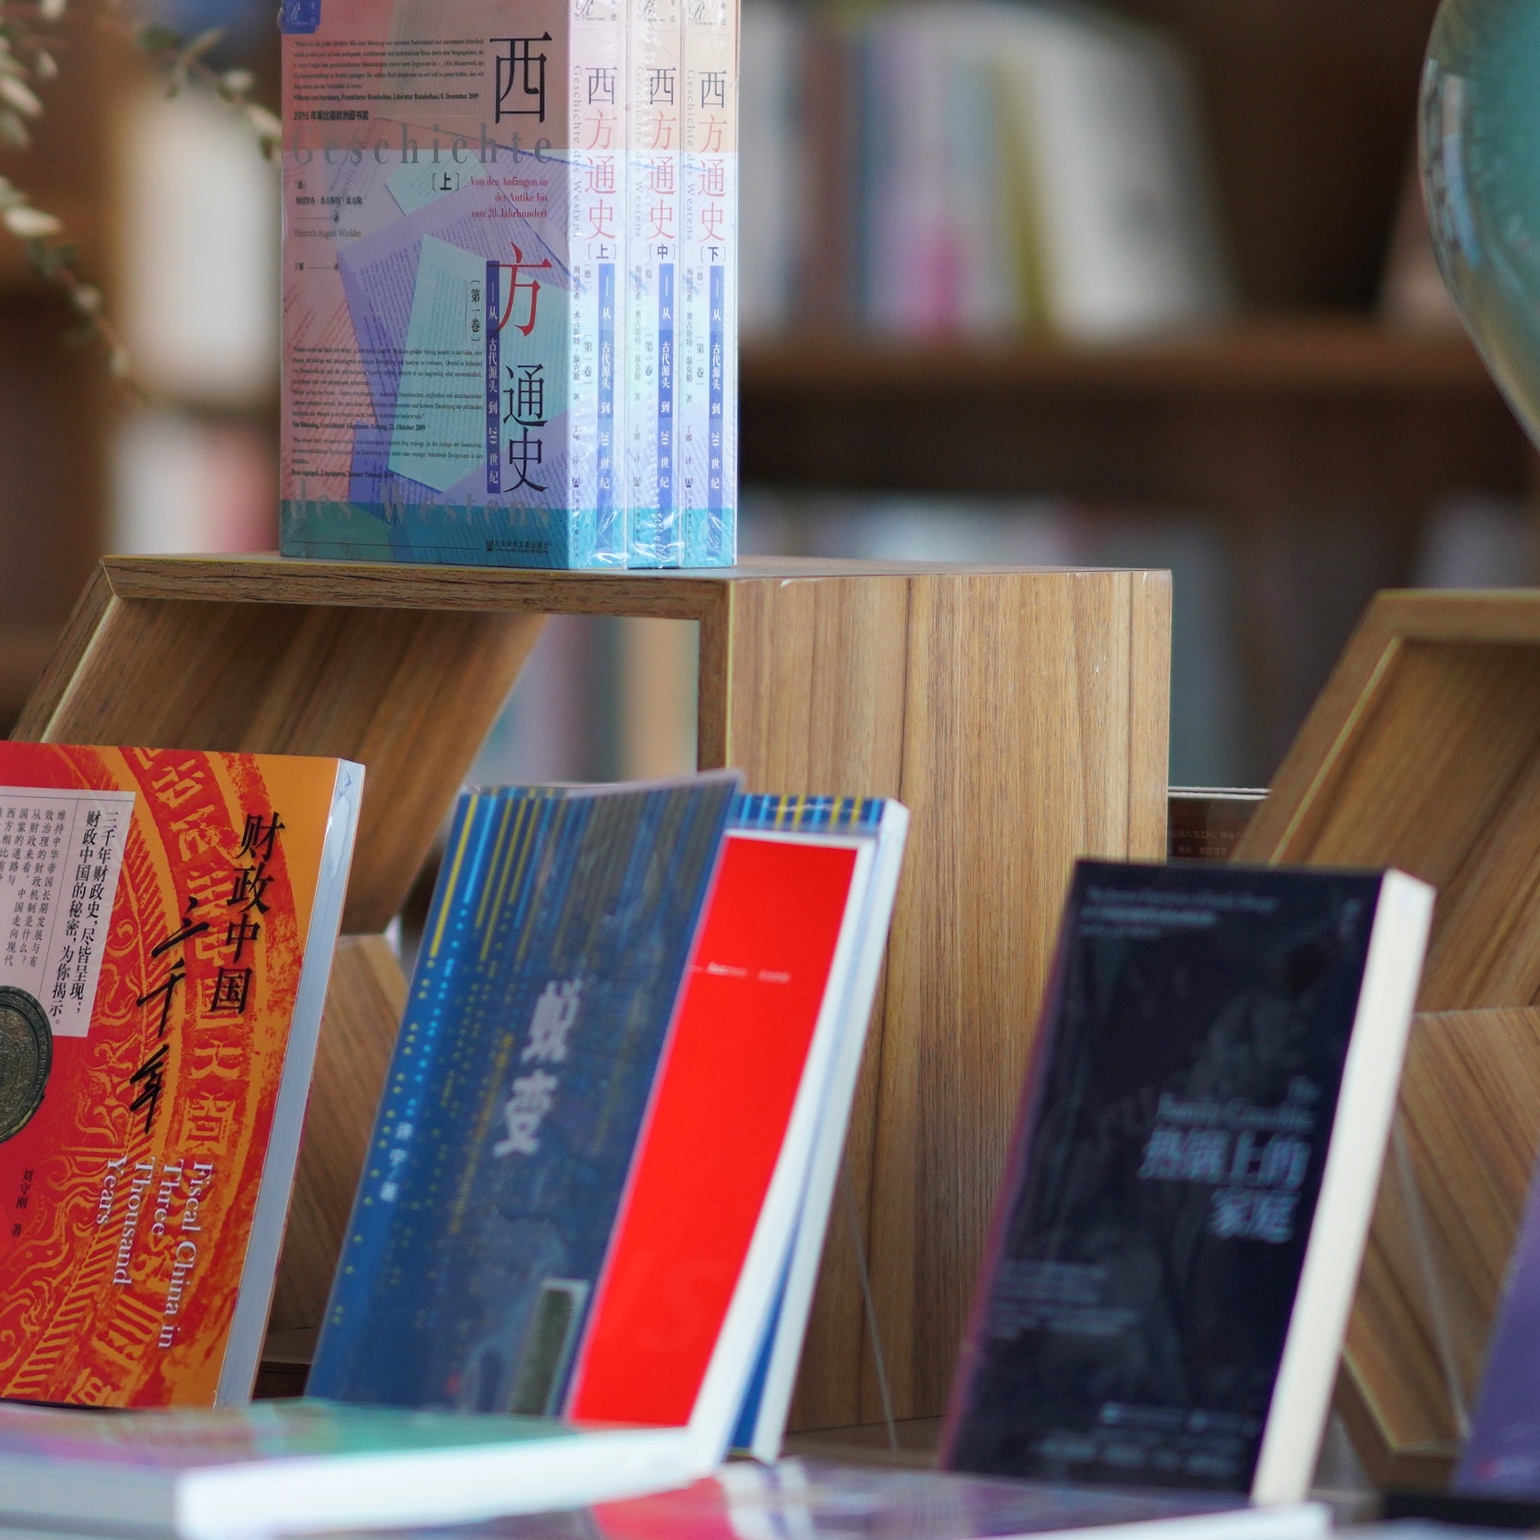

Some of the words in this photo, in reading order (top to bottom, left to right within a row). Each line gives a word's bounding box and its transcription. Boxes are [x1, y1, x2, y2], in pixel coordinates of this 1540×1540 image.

[292, 123, 552, 164] Geschichte
[584, 66, 618, 241] 西方通史
[646, 66, 677, 241] 西方通史
[697, 70, 728, 243] 西方通史
[470, 176, 485, 187] Von
[487, 176, 499, 187] den
[501, 176, 537, 187] Anfängen
[539, 176, 548, 187] in
[471, 207, 485, 218] zum
[499, 207, 547, 218] Jahrhundert
[495, 193, 509, 203] der
[511, 193, 535, 203] Antike
[536, 193, 548, 203] bis
[337, 228, 362, 239] Winkler
[380, 480, 551, 528] Westens
[7, 808, 29, 886] 国家的道路与
[48, 811, 102, 1025] 财政中国的秘密，为你揭示。
[69, 811, 120, 1015] 三千年财政史，尽皆呈现；
[210, 811, 286, 1015] 财政中国
[129, 895, 211, 1135] 三千年
[16, 1169, 34, 1210] 刘守刚
[95, 1154, 128, 1225] Years
[112, 1155, 156, 1286] Thousand
[151, 1158, 184, 1236] Three
[181, 1162, 214, 1232] Fiscal
[12, 1223, 23, 1237] 著
[164, 1241, 197, 1316] China
[158, 1324, 181, 1349] in
